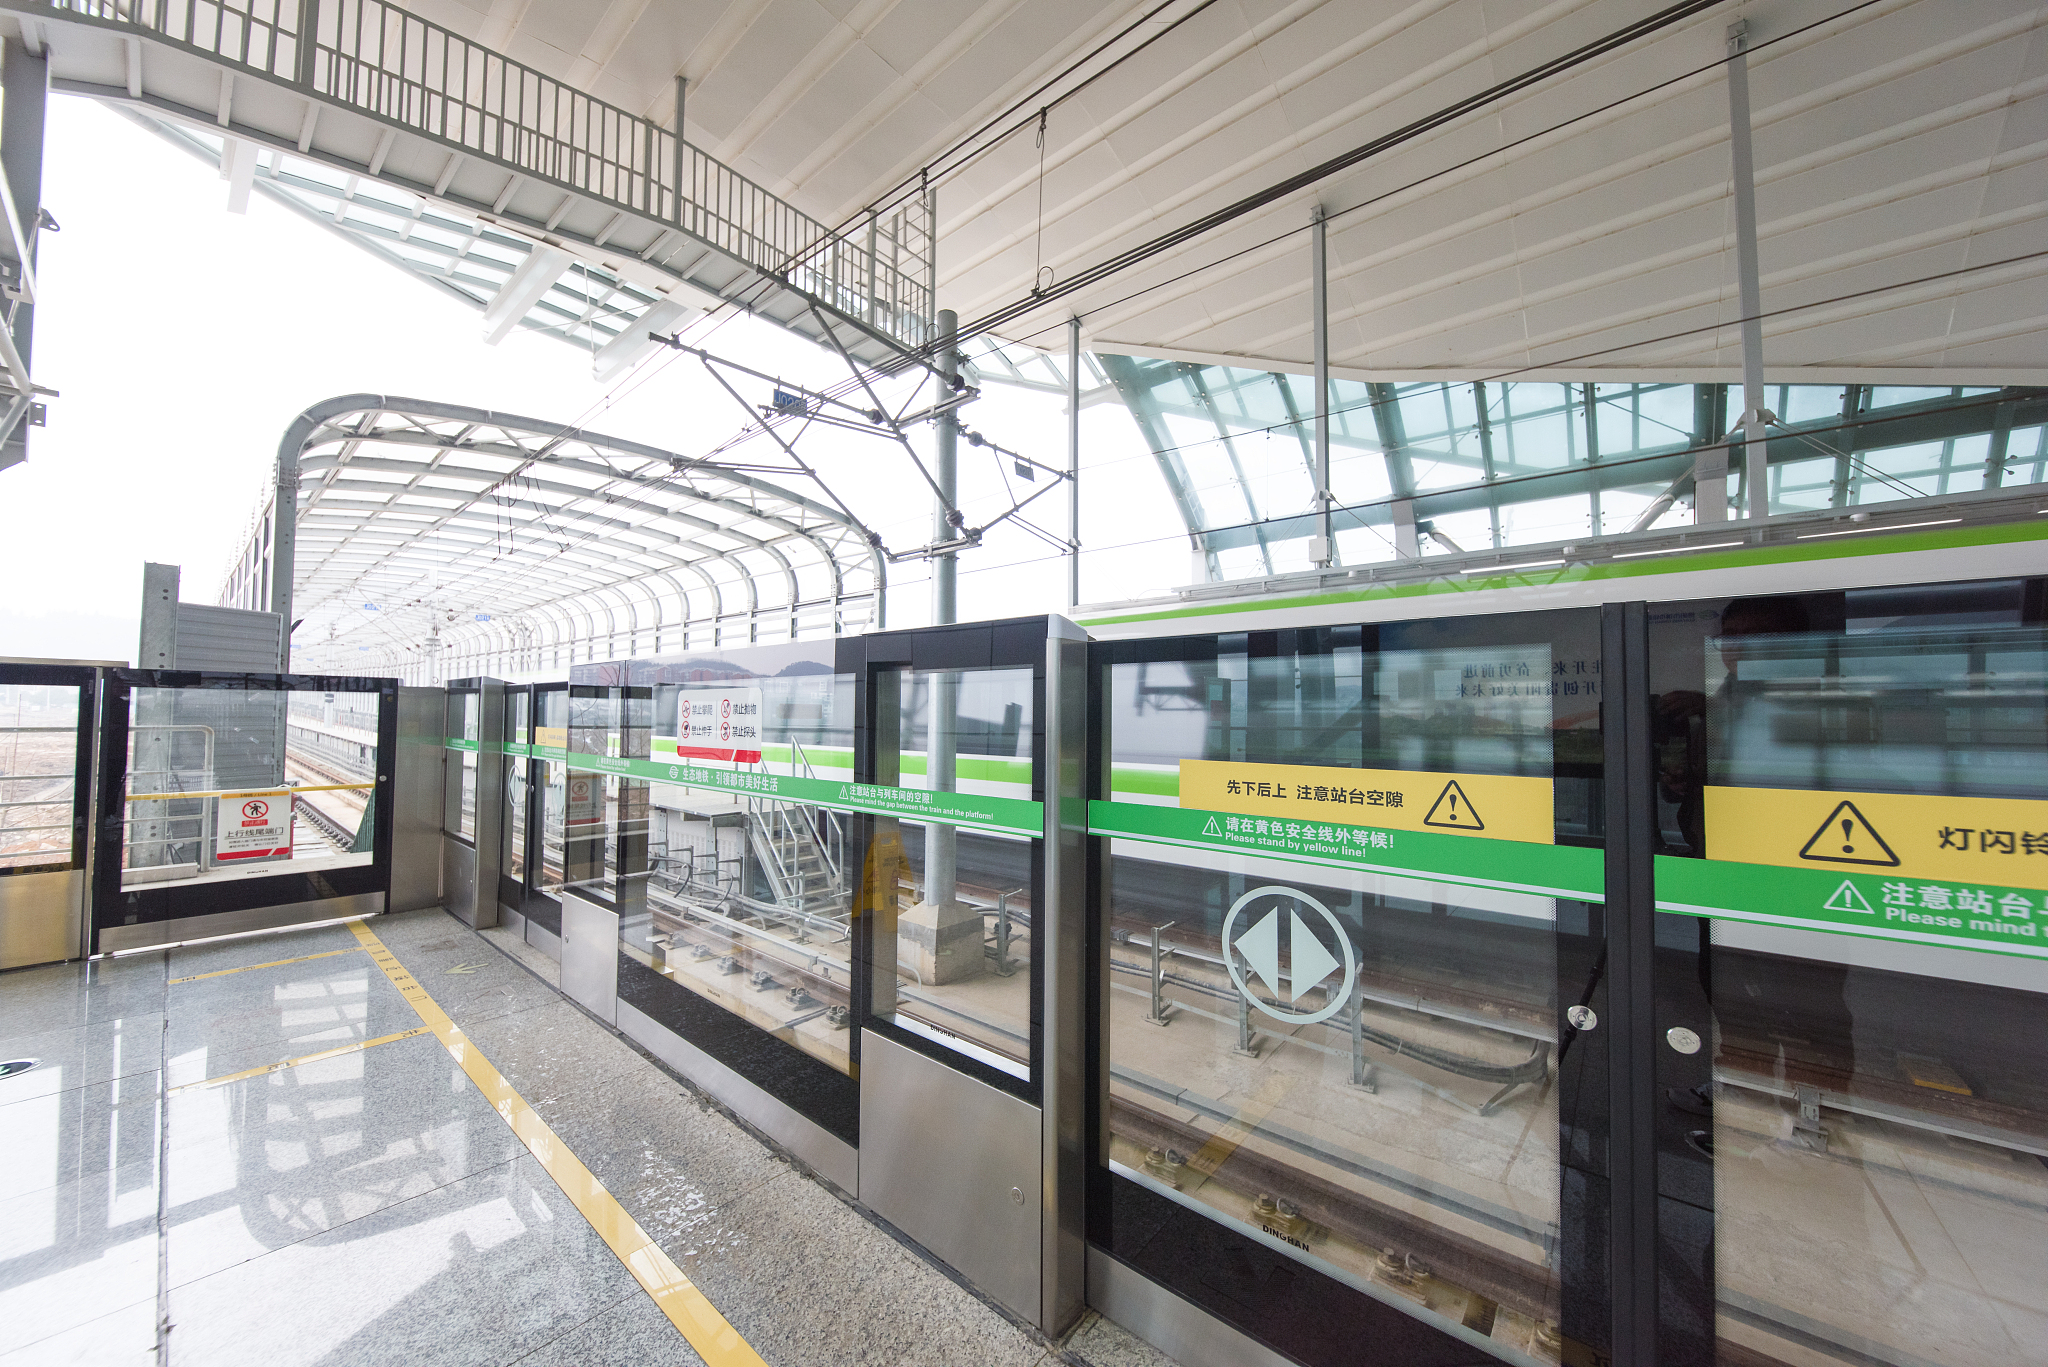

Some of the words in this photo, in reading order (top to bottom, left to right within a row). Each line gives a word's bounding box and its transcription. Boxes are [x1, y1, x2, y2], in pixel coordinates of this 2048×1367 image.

[732, 703, 756, 715] 禁止抛物
[691, 725, 712, 737] 禁止伸手
[732, 726, 756, 738] 禁止探头
[1227, 780, 1287, 799] 先下后上
[1297, 785, 1403, 808] 注意站台空隙
[850, 796, 864, 804] Please
[865, 797, 876, 805] mind
[886, 801, 895, 809] gap
[896, 801, 918, 811] between
[919, 804, 928, 812] the
[929, 805, 942, 814] train
[965, 810, 994, 820] platform!
[1225, 832, 1254, 844] Please
[1257, 836, 1285, 849] stand
[1287, 838, 1301, 851] by
[1302, 842, 1338, 854] yellow
[1341, 845, 1366, 858] line!
[1938, 826, 2048, 855] 灯闪铃
[1885, 906, 1962, 928] Please
[1970, 920, 2036, 936] mind
[1262, 1224, 1310, 1252] DINGHAN
